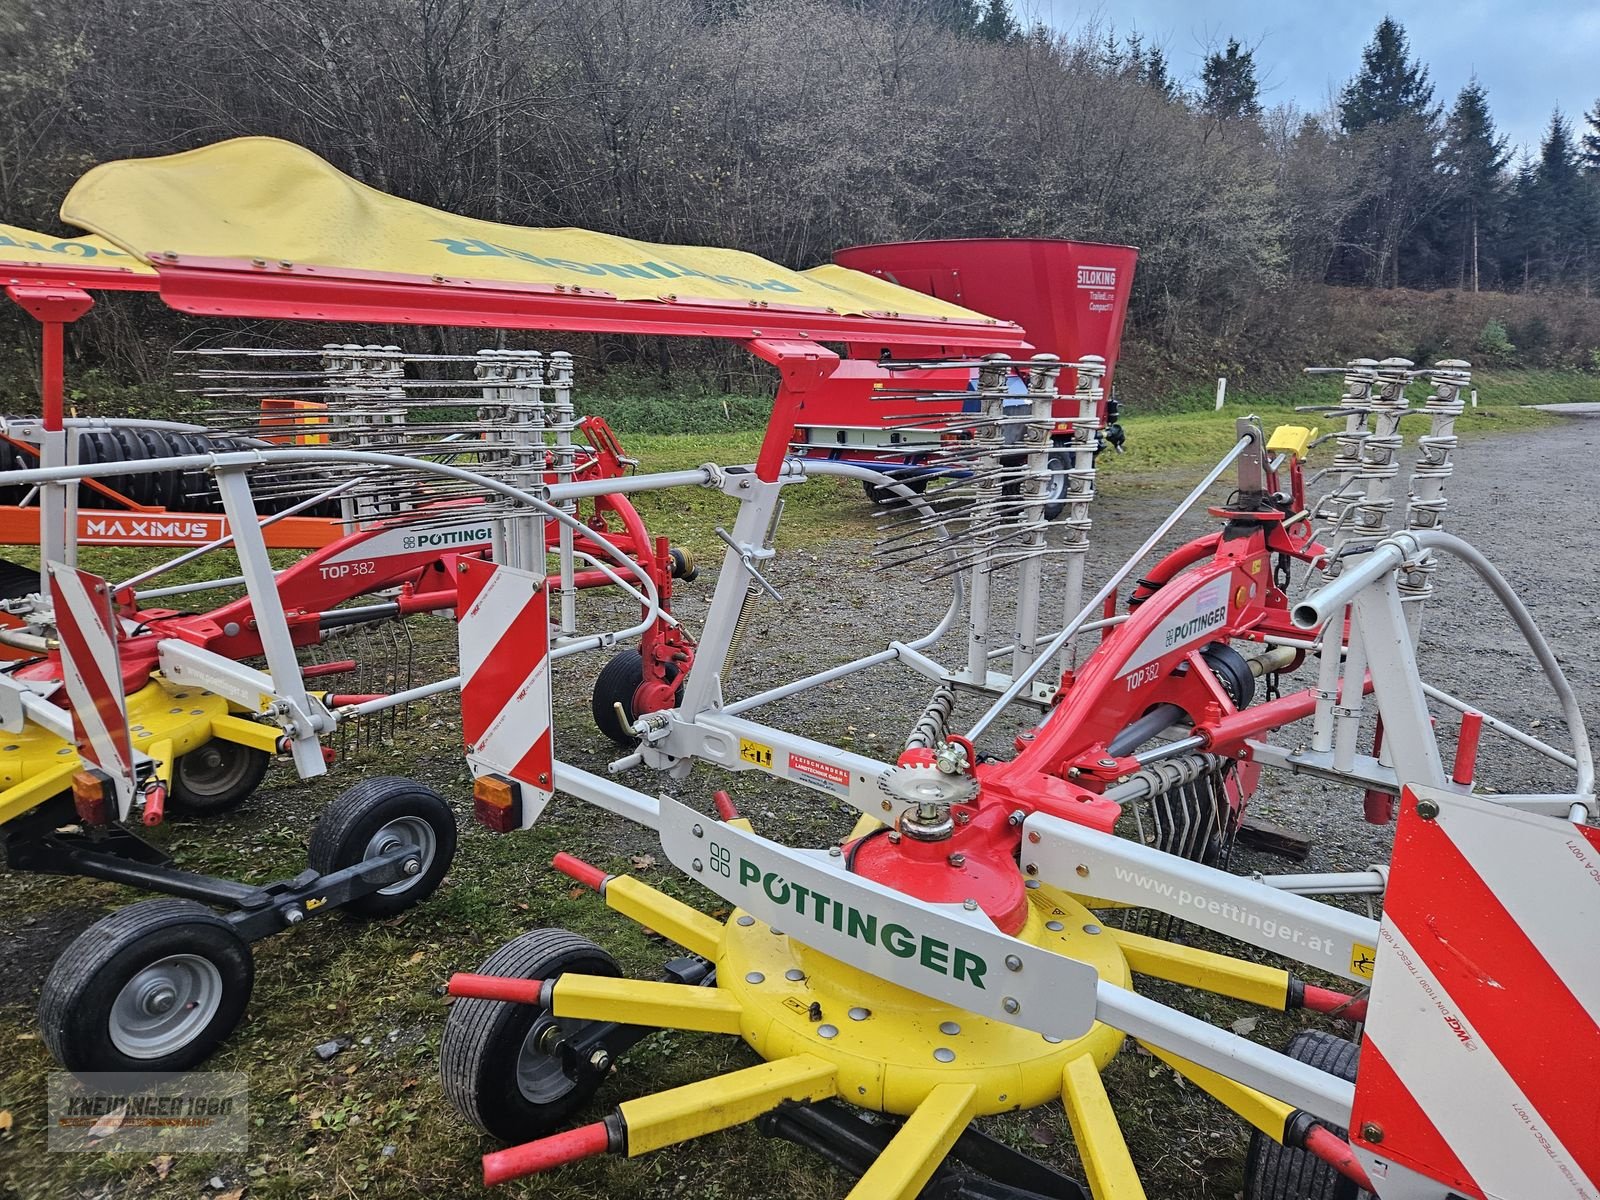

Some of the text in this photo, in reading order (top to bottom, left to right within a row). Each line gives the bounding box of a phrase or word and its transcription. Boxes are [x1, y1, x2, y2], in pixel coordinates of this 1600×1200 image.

[1077, 269, 1116, 286] SILOKING
[87, 519, 209, 538] MAXIMUS
[417, 527, 506, 548] PÖTTINGE
[319, 561, 376, 580] TOP 382
[1126, 662, 1160, 692] TOP 382
[790, 754, 849, 778] FLEISCHANDERL
[1565, 840, 1587, 862] 10071
[1114, 866, 1335, 956] www.poettinger.at
[1419, 978, 1439, 1001] 11030
[1435, 1000, 1451, 1017] DIN
[1444, 1015, 1471, 1042] WGF
[1512, 1102, 1532, 1124] 10071
